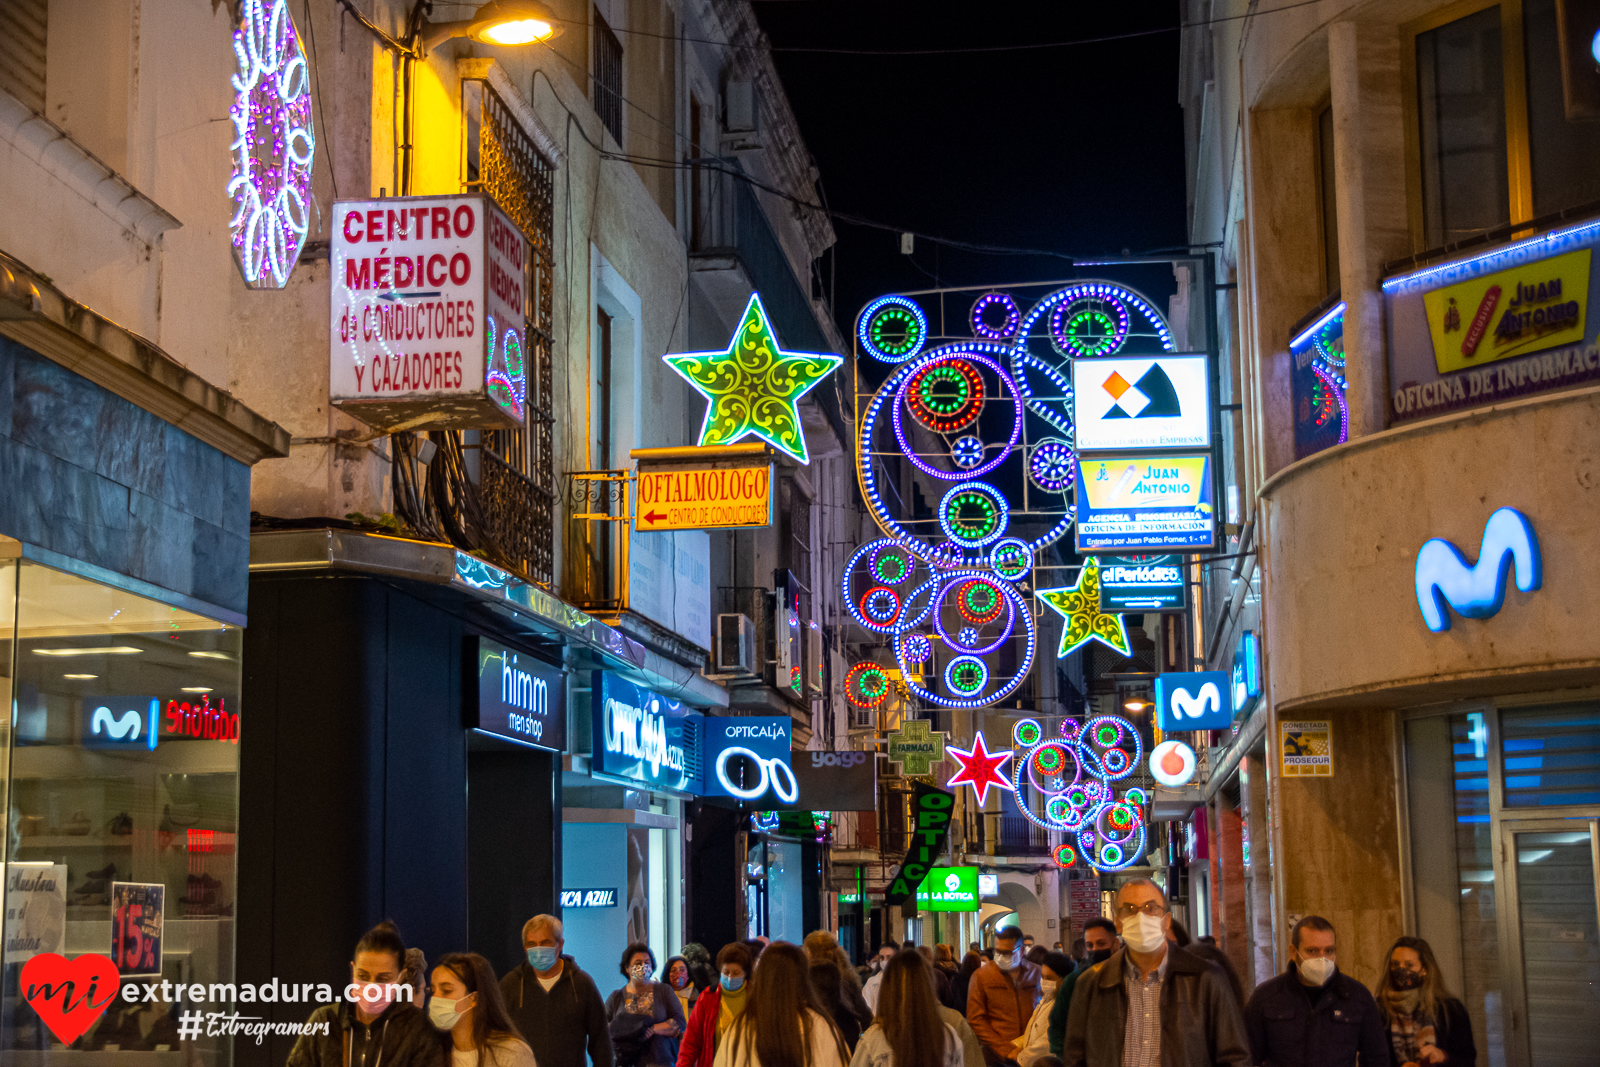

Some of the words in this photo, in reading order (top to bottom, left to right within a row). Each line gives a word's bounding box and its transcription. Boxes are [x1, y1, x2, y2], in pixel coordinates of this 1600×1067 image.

[343, 204, 475, 244] CENTRO
[488, 208, 522, 271] CENTRO
[346, 248, 471, 291] MÉDICO
[489, 253, 522, 315] MÉDICO
[1510, 278, 1562, 307] JUAN
[341, 306, 358, 343] de
[363, 300, 475, 342] CONDUCTORES
[1466, 294, 1496, 349] EXCLUSIVAS
[1493, 300, 1579, 336] ANTONIO
[354, 365, 366, 393] Y
[372, 351, 463, 393] CAZADORES
[1394, 372, 1466, 414] OFICINA
[1469, 368, 1494, 398] DE
[1159, 435, 1203, 444] EMPRESAS
[641, 469, 766, 504] OFTALMOLOGO
[1130, 480, 1190, 494] ANTONIO
[1142, 465, 1179, 479] JUAN
[668, 507, 698, 525] CENTRO
[700, 507, 709, 524] DE
[711, 504, 766, 524] CONDUCTORES
[1084, 524, 1122, 533] OFICINA
[1125, 524, 1137, 532] DE
[1140, 520, 1205, 531] INFORMACIÓN
[1087, 514, 1130, 523] AGENCIA
[1135, 511, 1201, 521] INMOBILIARIA
[1087, 538, 1112, 546] Entrada
[1126, 537, 1142, 545] Juan
[1143, 537, 1163, 545] Pablo
[501, 650, 548, 716] himm
[508, 712, 525, 733] men
[525, 713, 543, 742] shop
[811, 751, 866, 768] yoigo
[891, 793, 951, 895] OPTICA
[931, 892, 942, 900] LA
[943, 892, 974, 900] BOTICA
